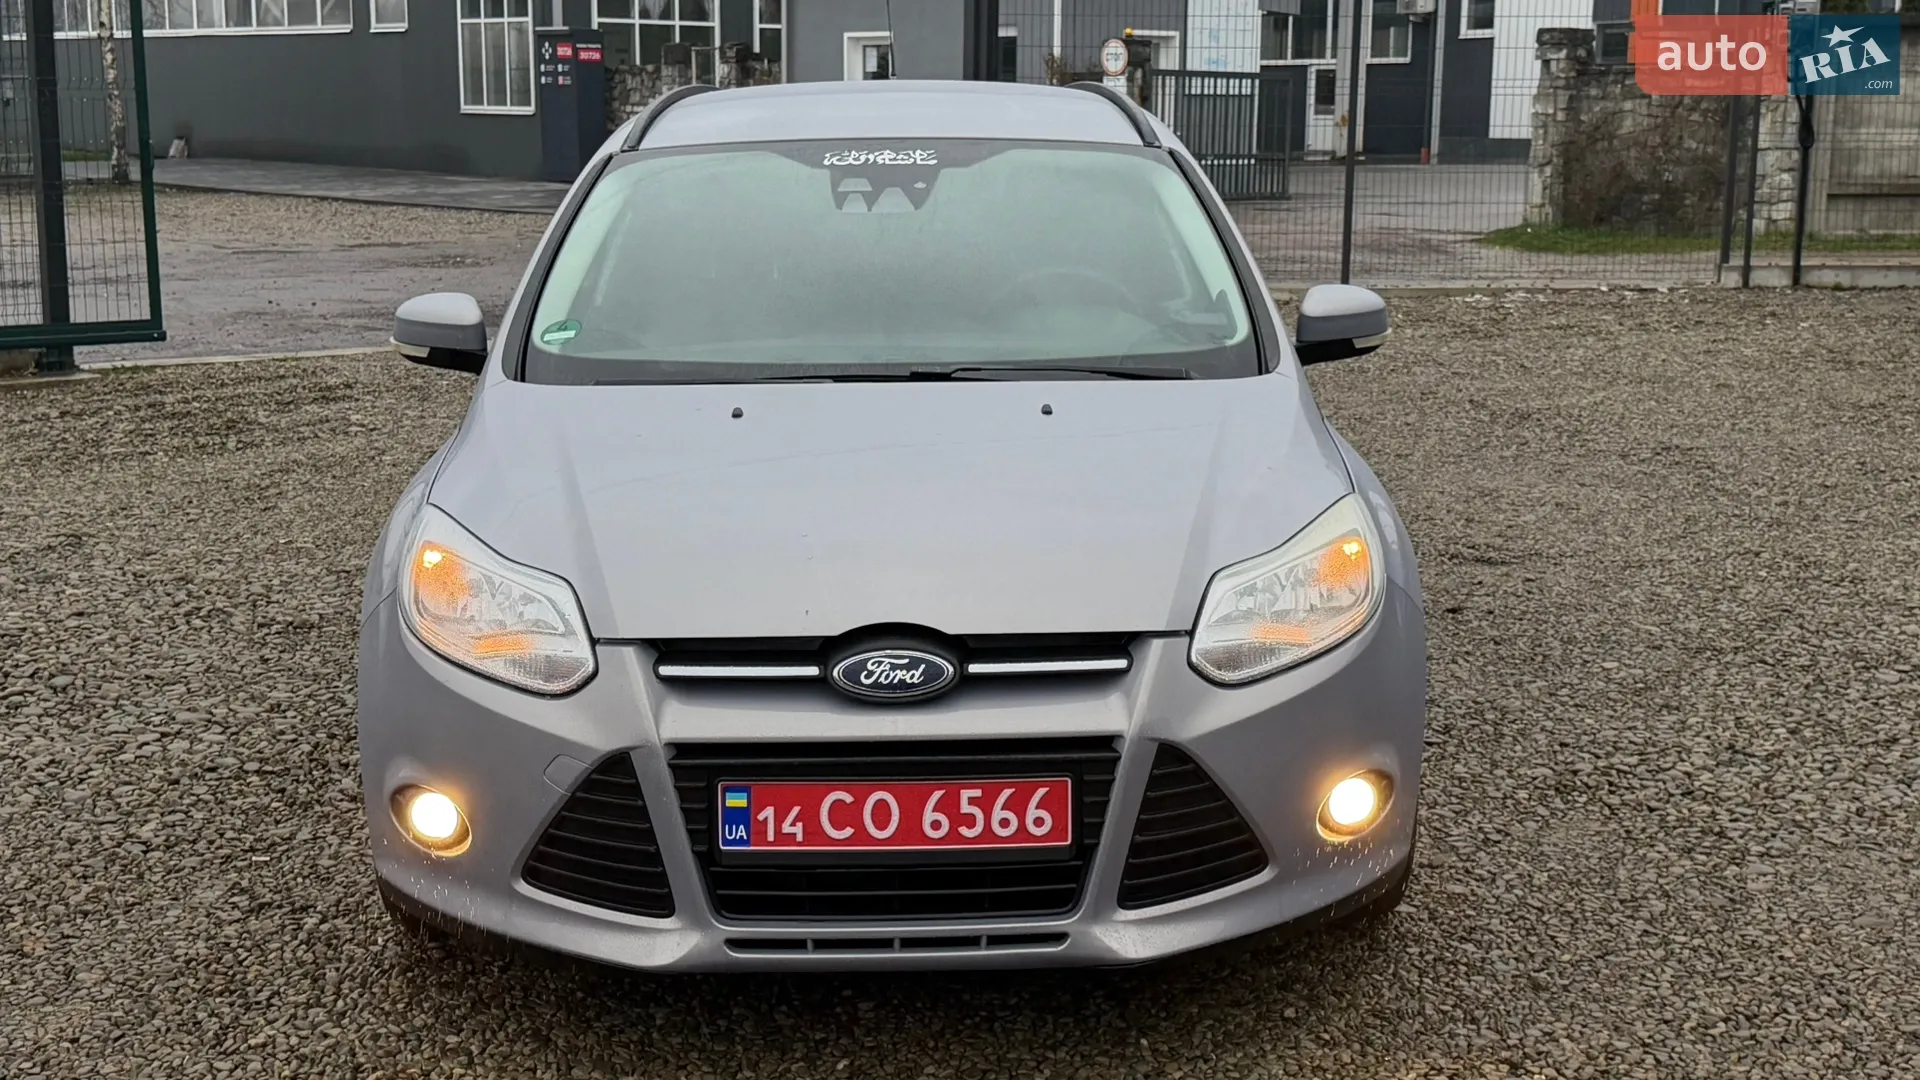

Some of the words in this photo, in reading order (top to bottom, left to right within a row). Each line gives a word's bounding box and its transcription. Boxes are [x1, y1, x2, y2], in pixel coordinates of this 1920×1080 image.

[860, 657, 926, 685] Ford
[756, 806, 804, 842] 14
[819, 790, 900, 840] CO
[922, 787, 1053, 839] 6566
[725, 824, 747, 840] UA
